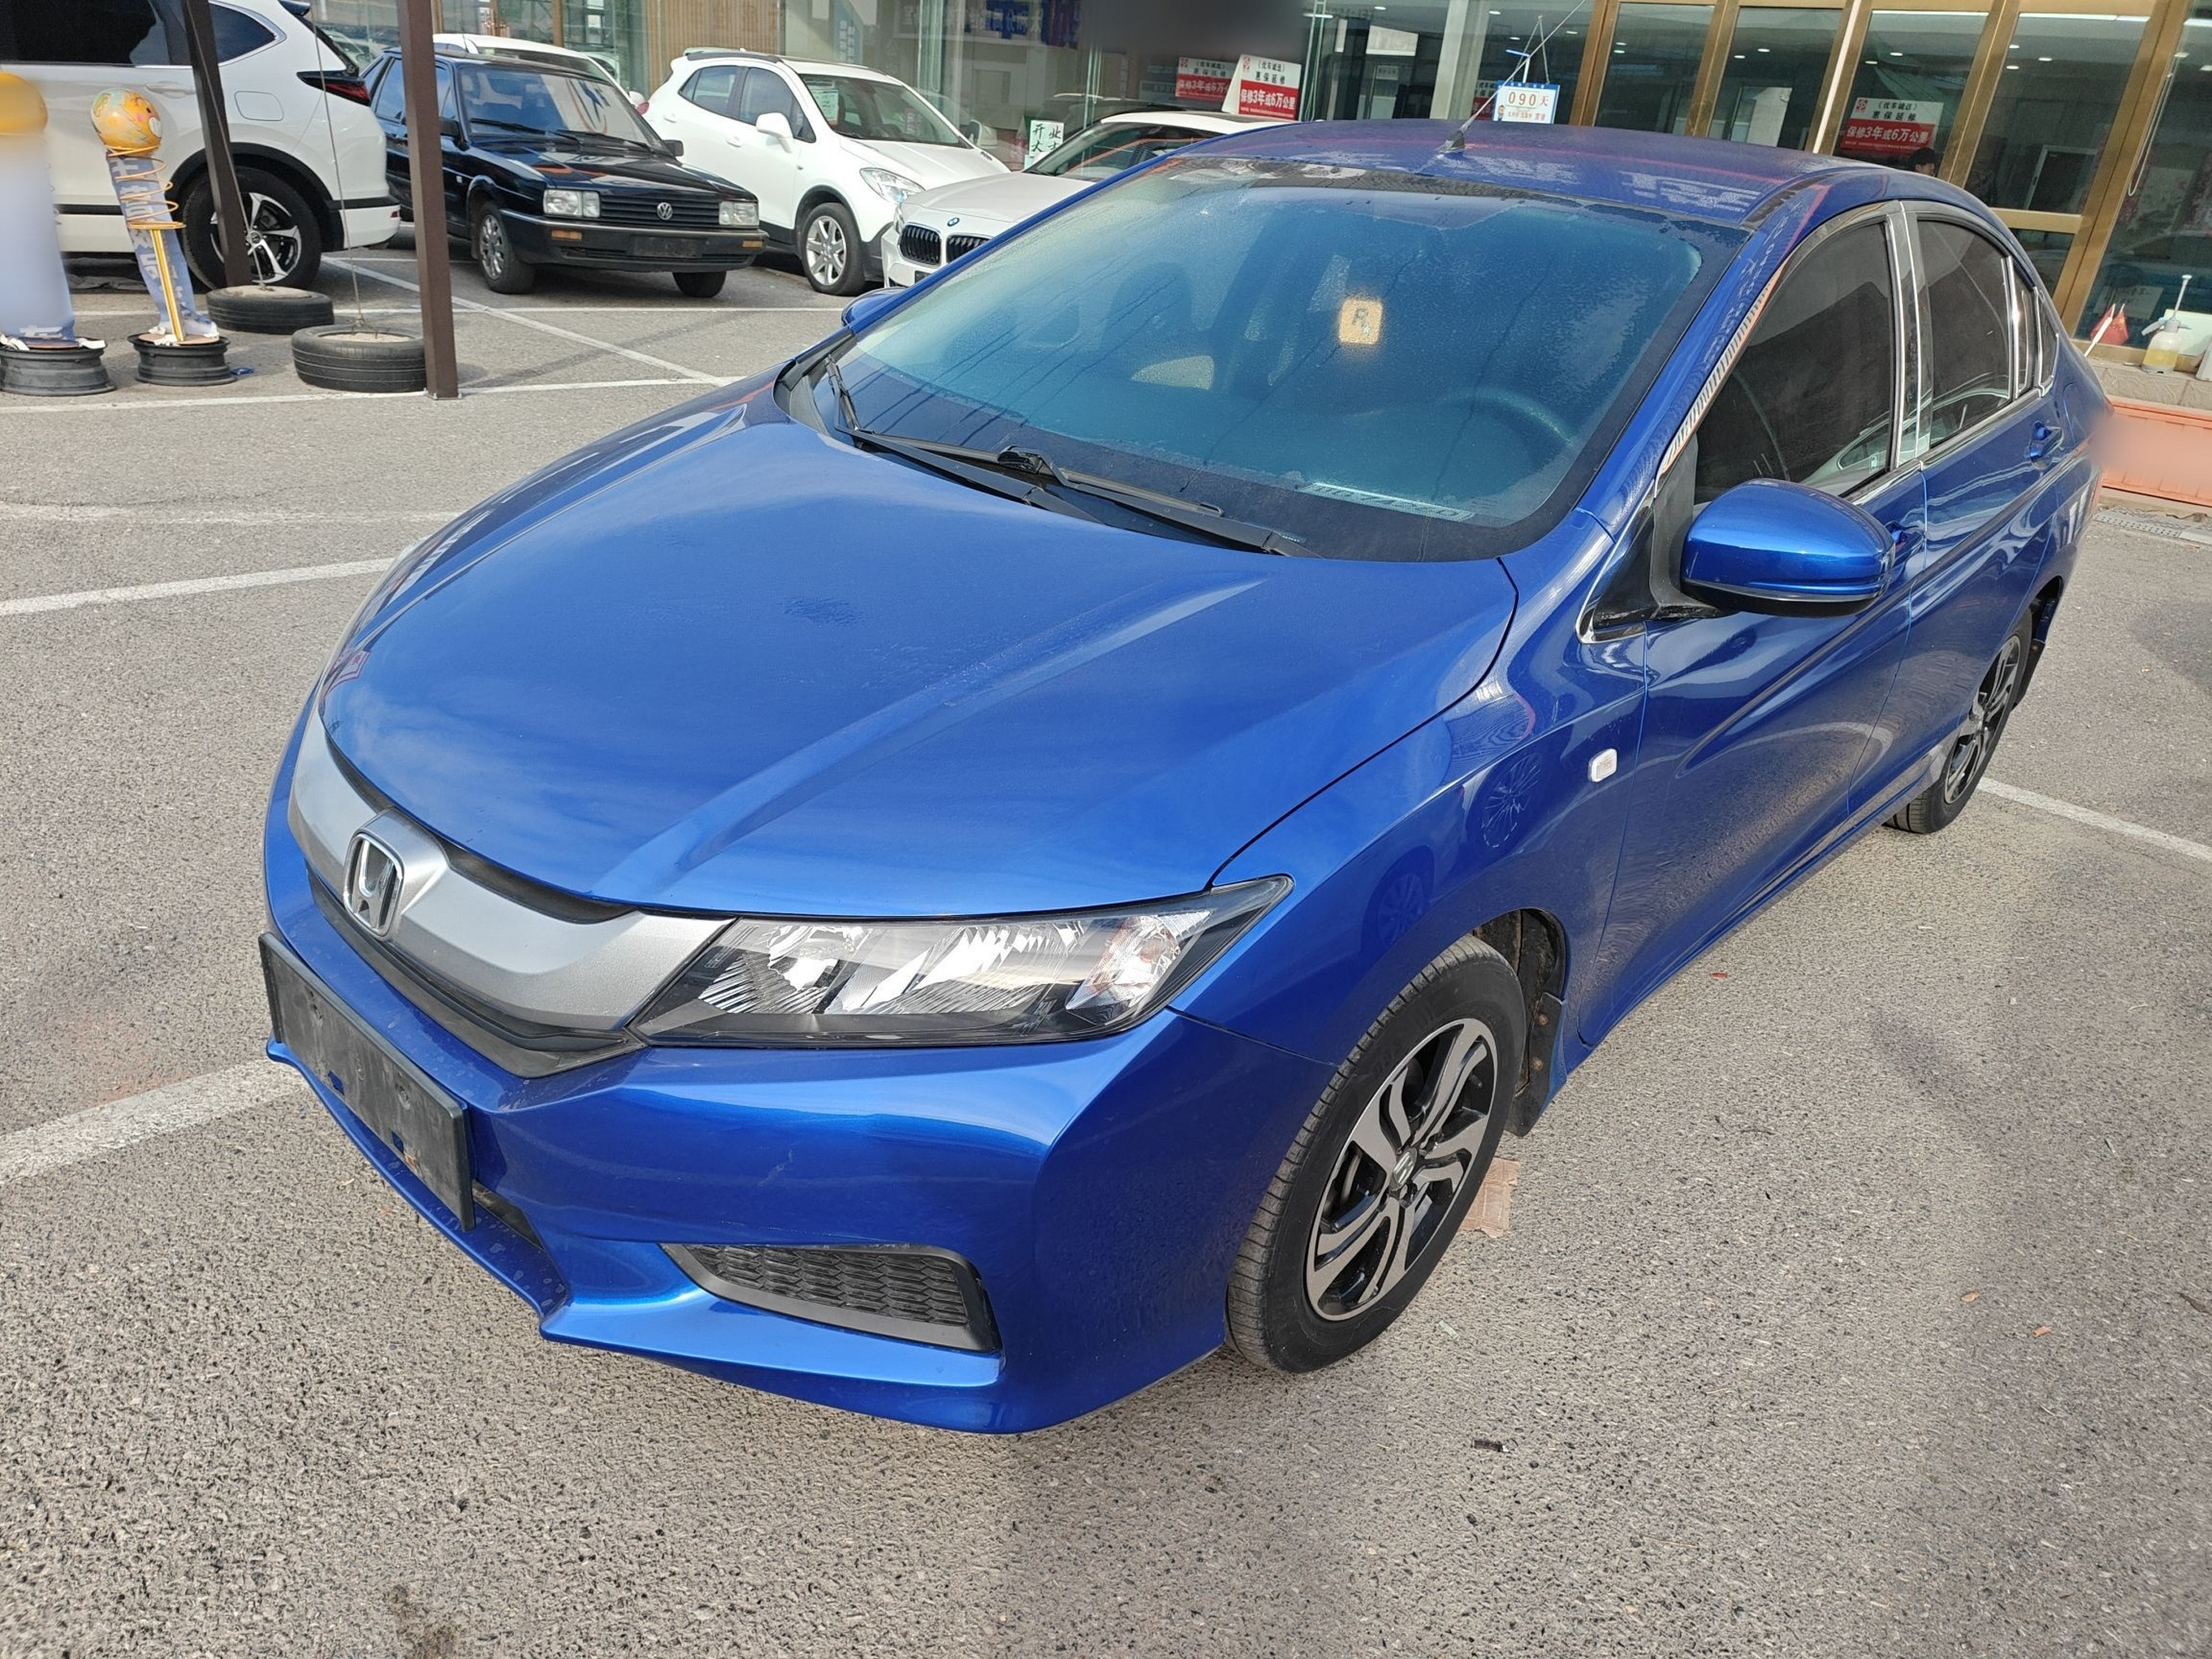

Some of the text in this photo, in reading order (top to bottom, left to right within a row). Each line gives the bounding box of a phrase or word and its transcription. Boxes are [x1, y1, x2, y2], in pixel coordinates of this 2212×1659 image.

[1240, 89, 1296, 109] 保修3年或6万公里
[1032, 123, 1061, 139] 开业
[1847, 126, 1929, 143] 保修3年或6万公里
